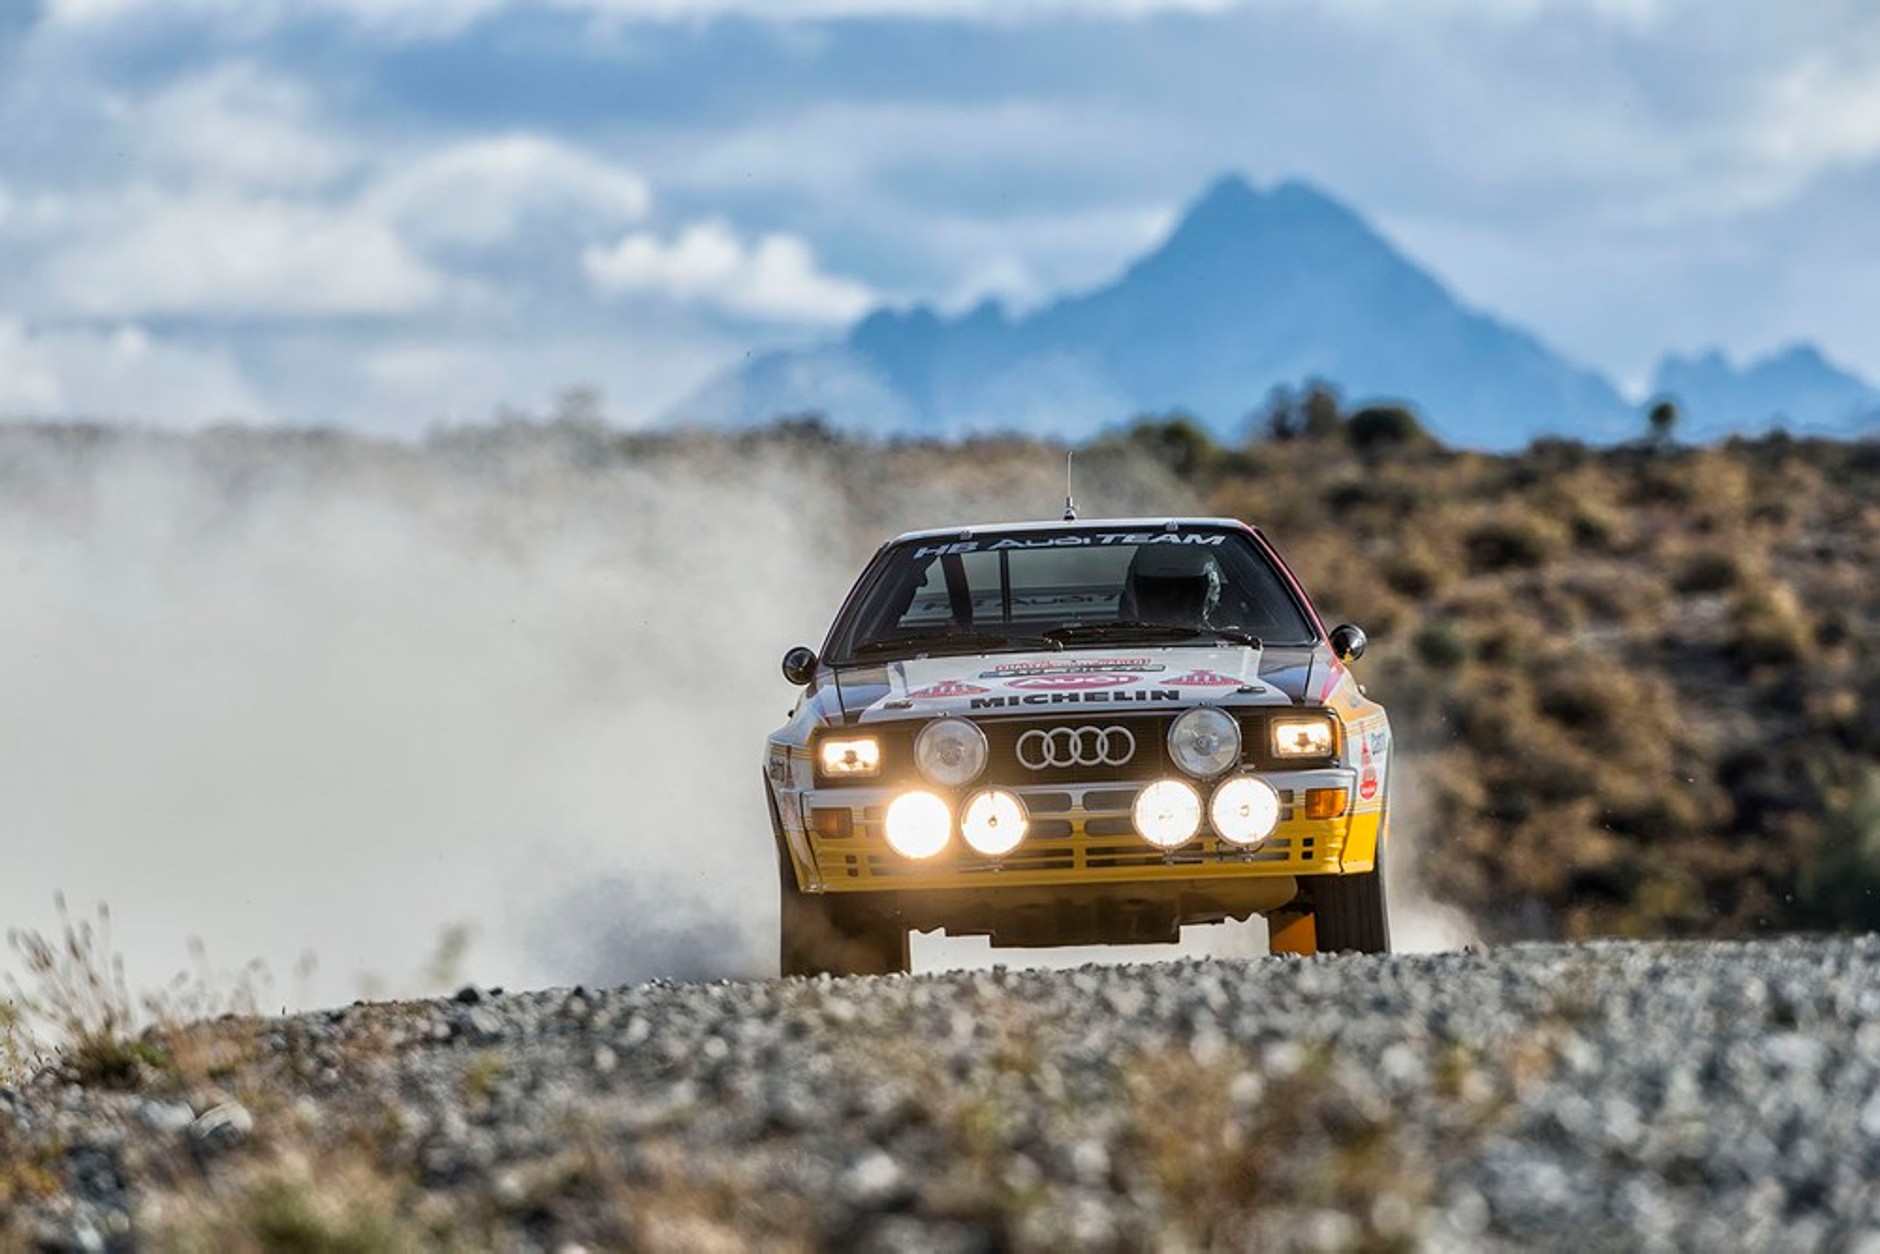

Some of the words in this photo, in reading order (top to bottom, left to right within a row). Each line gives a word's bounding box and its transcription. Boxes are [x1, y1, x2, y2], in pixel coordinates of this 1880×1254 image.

[913, 541, 980, 560] HB
[1096, 533, 1227, 546] TEAM
[1016, 675, 1130, 687] AUDI
[970, 690, 1180, 710] MICHELIN
